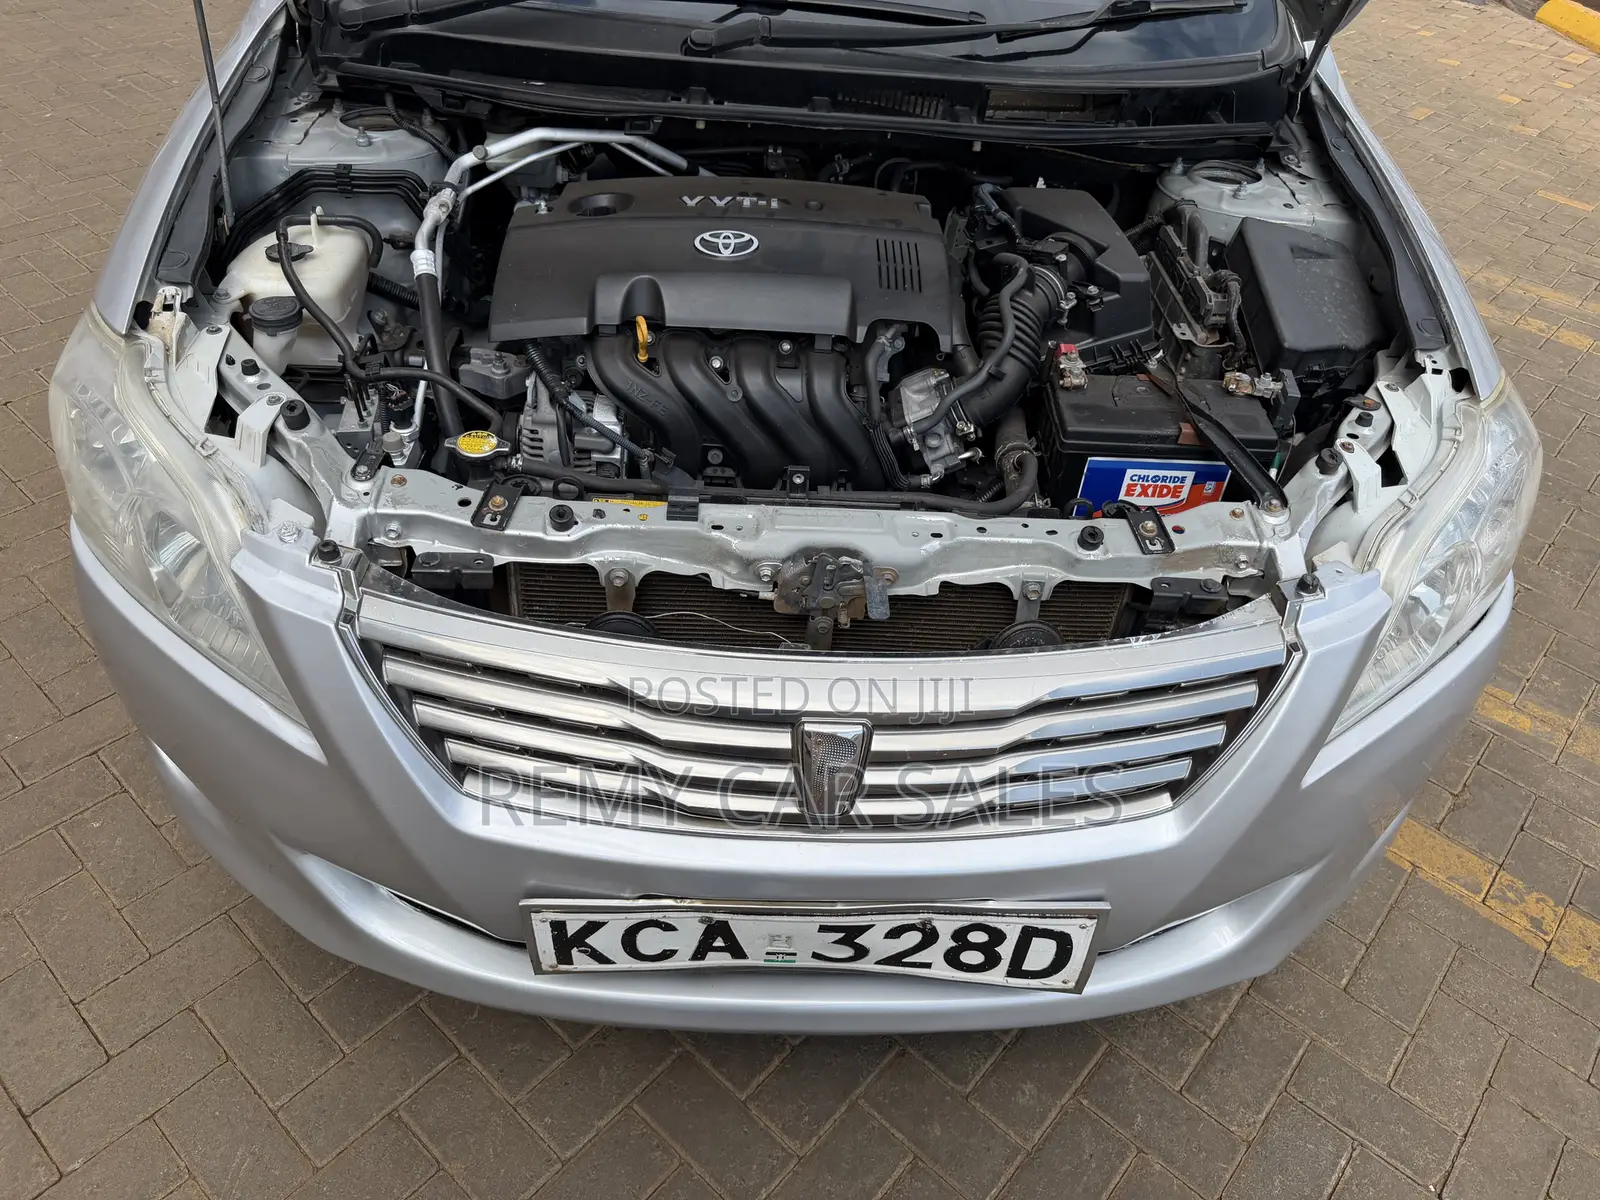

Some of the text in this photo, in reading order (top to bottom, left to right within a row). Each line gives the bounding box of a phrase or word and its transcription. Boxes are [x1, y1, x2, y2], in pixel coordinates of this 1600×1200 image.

[1130, 474, 1187, 484] CHLORIDE
[1124, 483, 1184, 498] EXIDE
[550, 919, 1073, 979] KCA 328D
